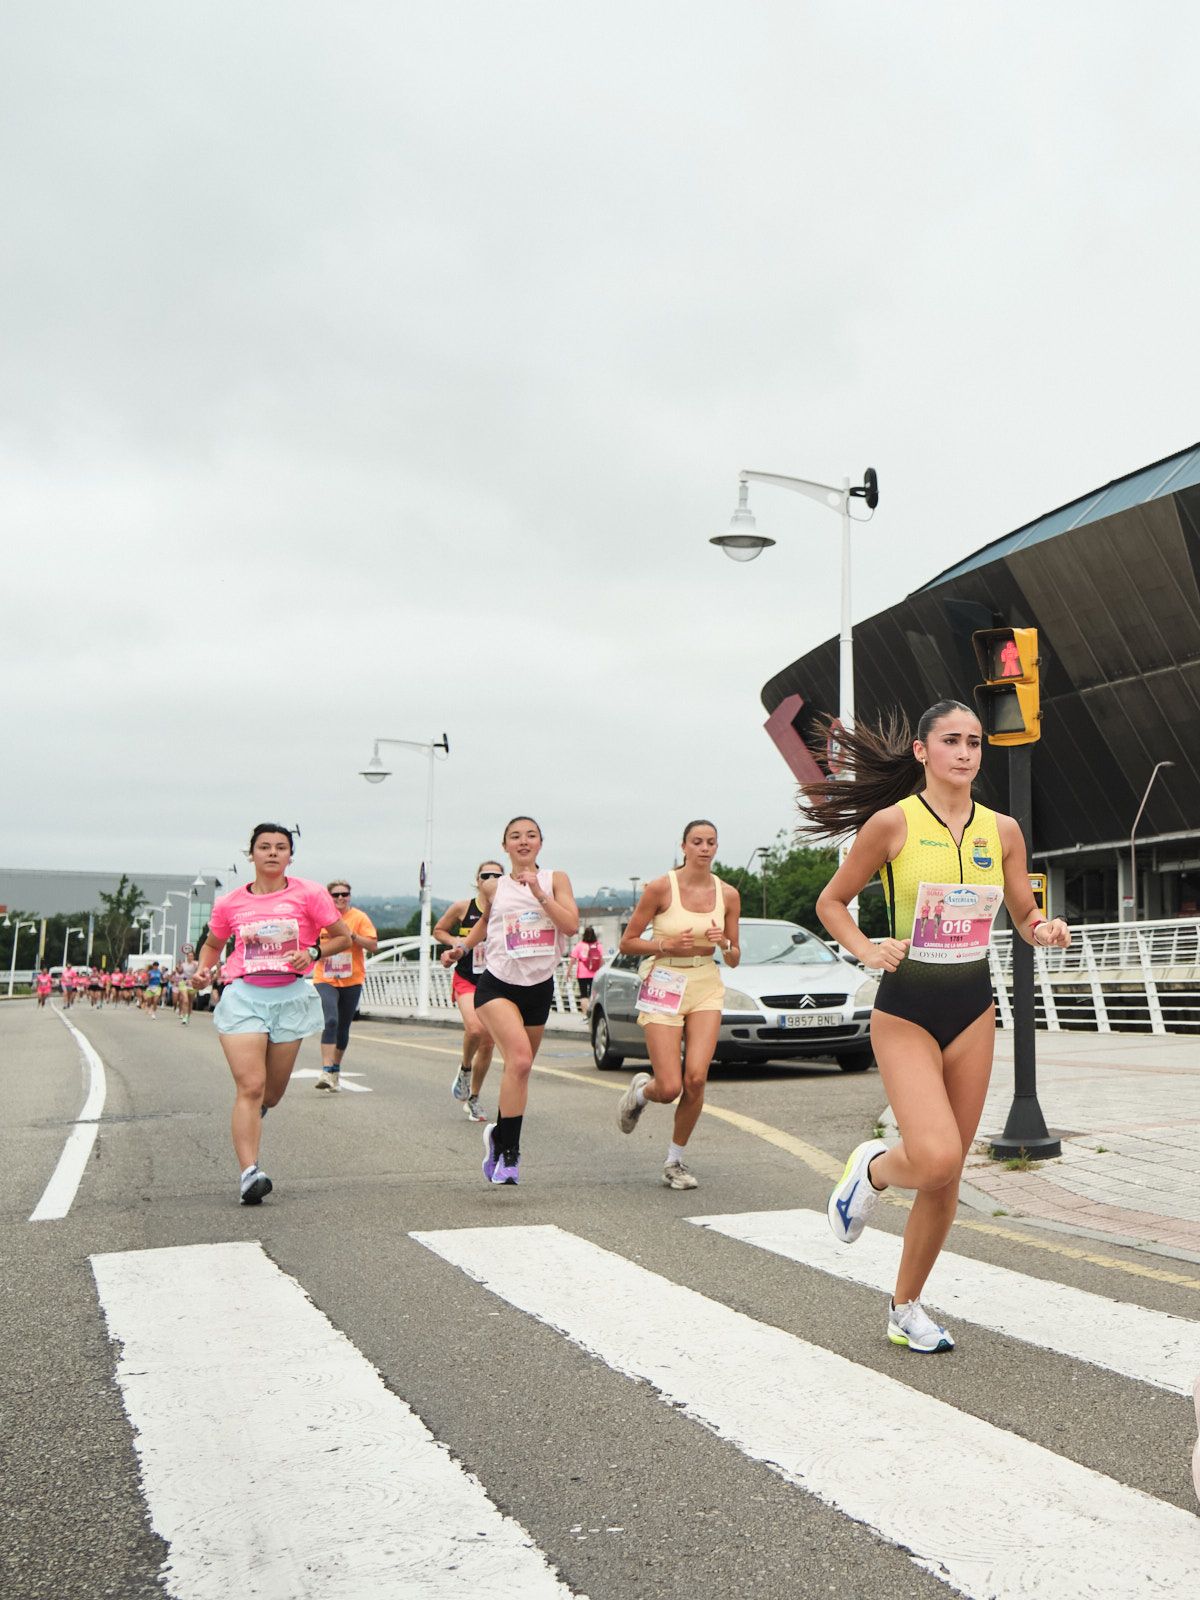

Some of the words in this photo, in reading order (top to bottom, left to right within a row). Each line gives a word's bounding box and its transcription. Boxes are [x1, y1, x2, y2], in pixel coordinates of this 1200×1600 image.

[942, 920, 972, 934] 016
[520, 930, 541, 939] 016
[261, 943, 282, 951] 016
[647, 986, 666, 999] 016
[787, 1016, 814, 1027] 9857
[817, 1015, 836, 1026] BNL
